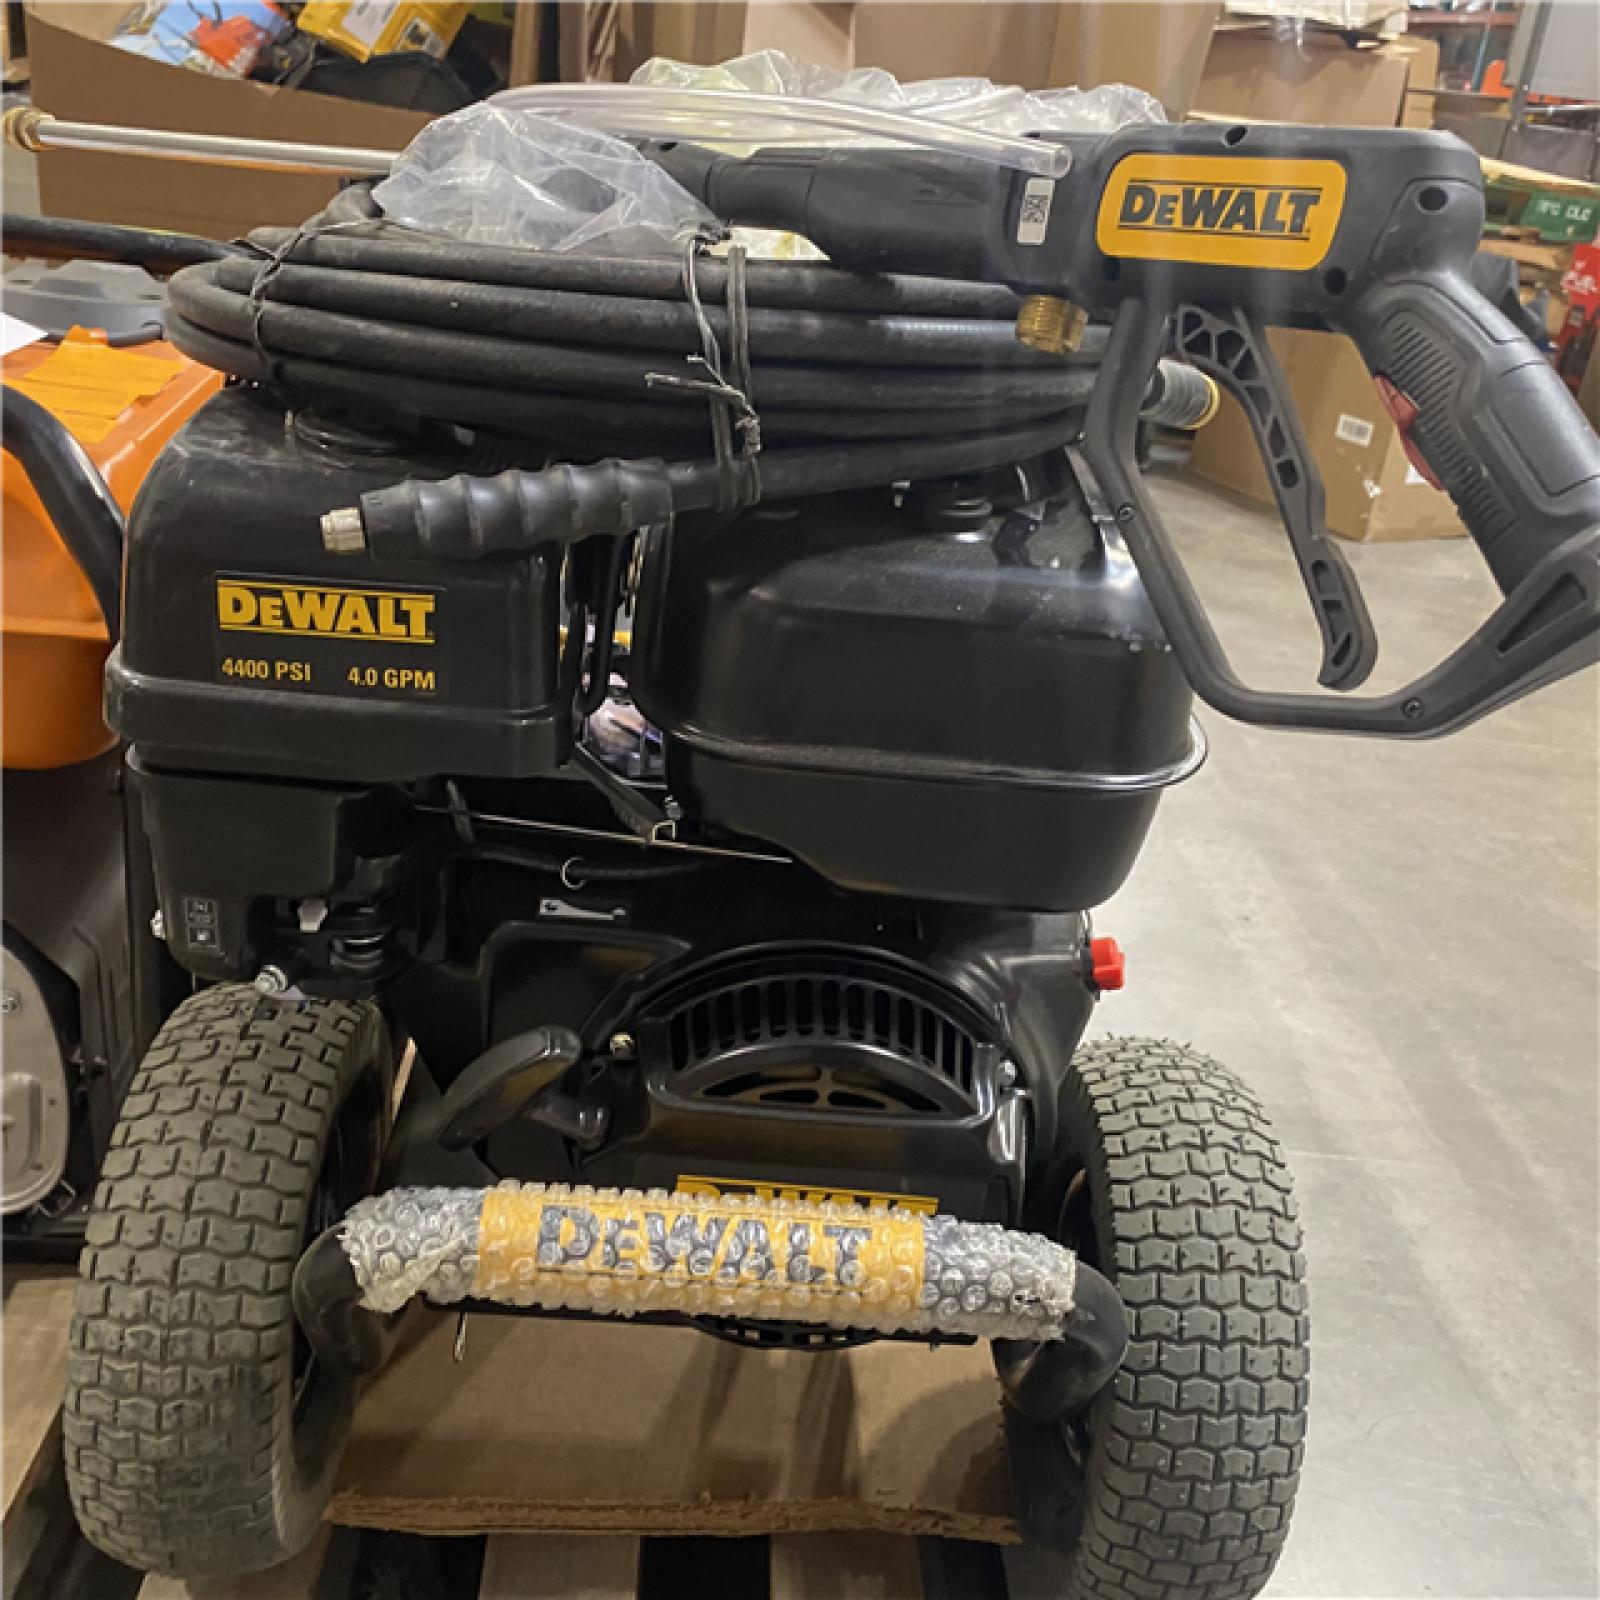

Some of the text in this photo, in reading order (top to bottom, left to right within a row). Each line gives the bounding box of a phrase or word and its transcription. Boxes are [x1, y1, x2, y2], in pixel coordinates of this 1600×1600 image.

[1119, 184, 1321, 233] DEWALT
[219, 586, 436, 638] DEWALT
[221, 656, 437, 691] 4400 PSI 4.0 GPM
